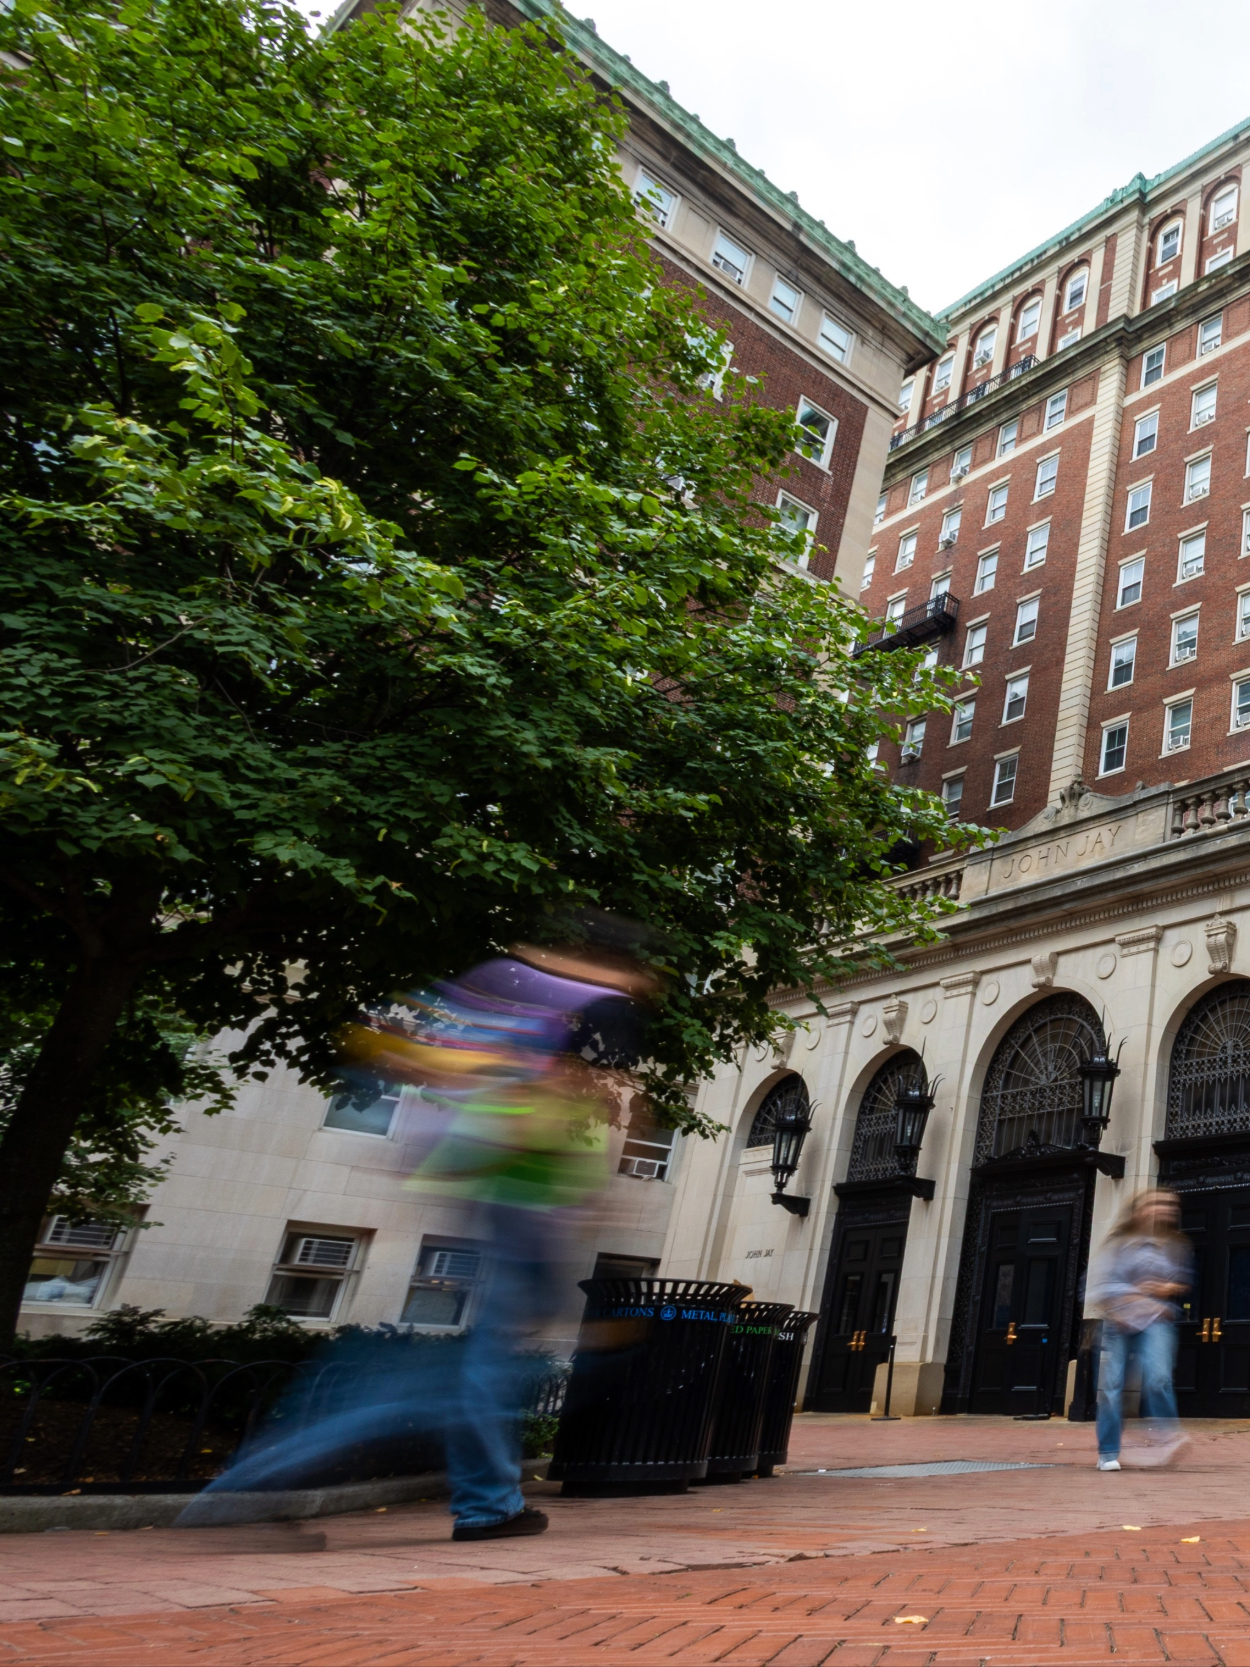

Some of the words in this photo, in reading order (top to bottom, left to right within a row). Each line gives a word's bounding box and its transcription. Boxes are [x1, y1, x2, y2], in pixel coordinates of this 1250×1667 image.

[1003, 841, 1070, 879] JOHN
[1076, 825, 1122, 856] JAY
[745, 1249, 763, 1259] JOHN
[603, 1306, 655, 1318] CARTONS
[681, 1309, 718, 1323] METAL,
[746, 1325, 772, 1335] PAPER
